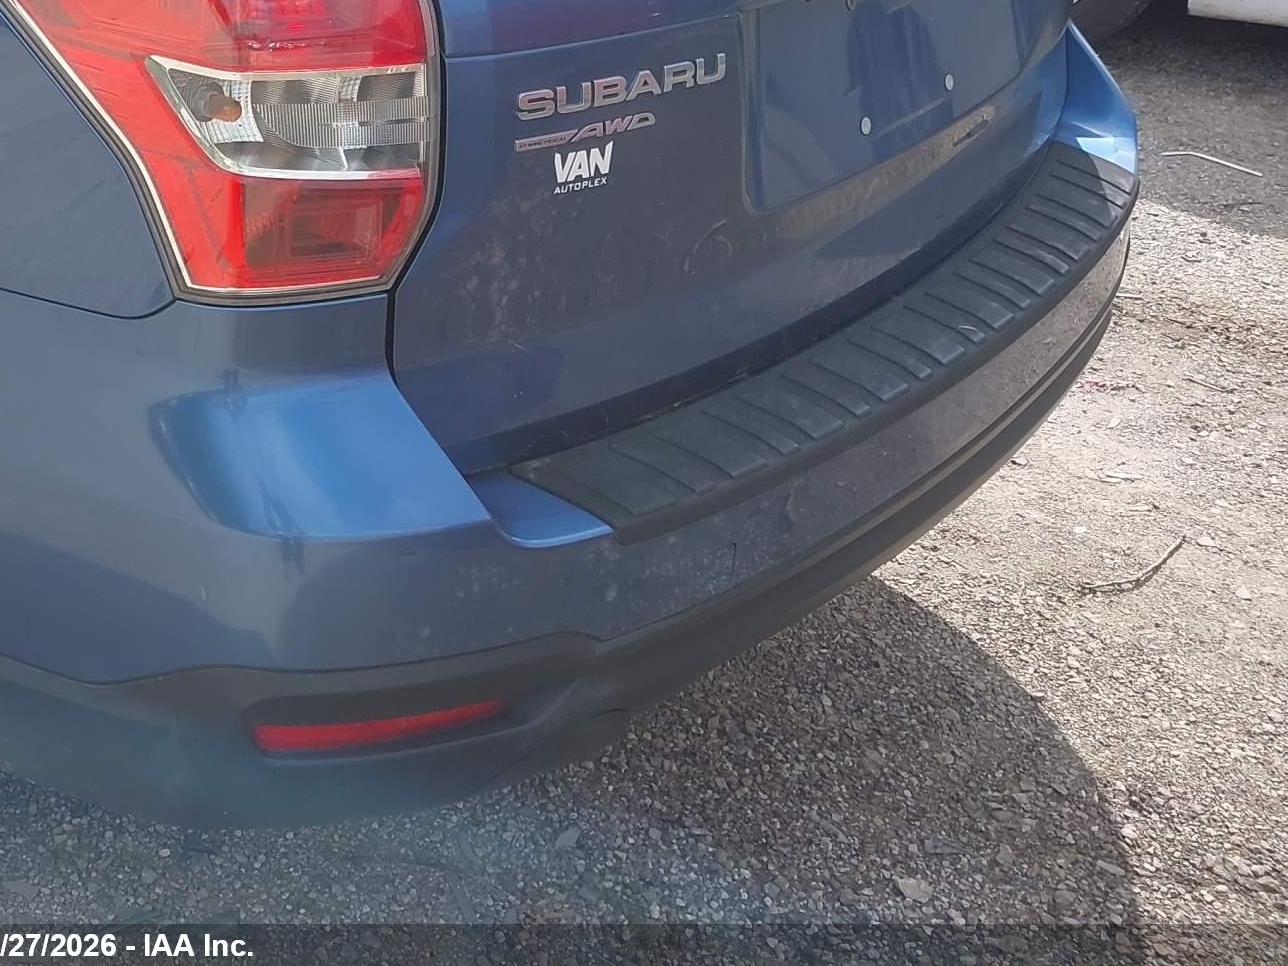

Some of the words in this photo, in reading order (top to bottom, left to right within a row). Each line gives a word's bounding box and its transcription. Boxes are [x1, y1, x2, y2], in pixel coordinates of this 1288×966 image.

[516, 53, 726, 121] SUBARU
[570, 112, 656, 143] AWD
[554, 140, 614, 184] VAN
[553, 176, 608, 195] AUTOPLEX
